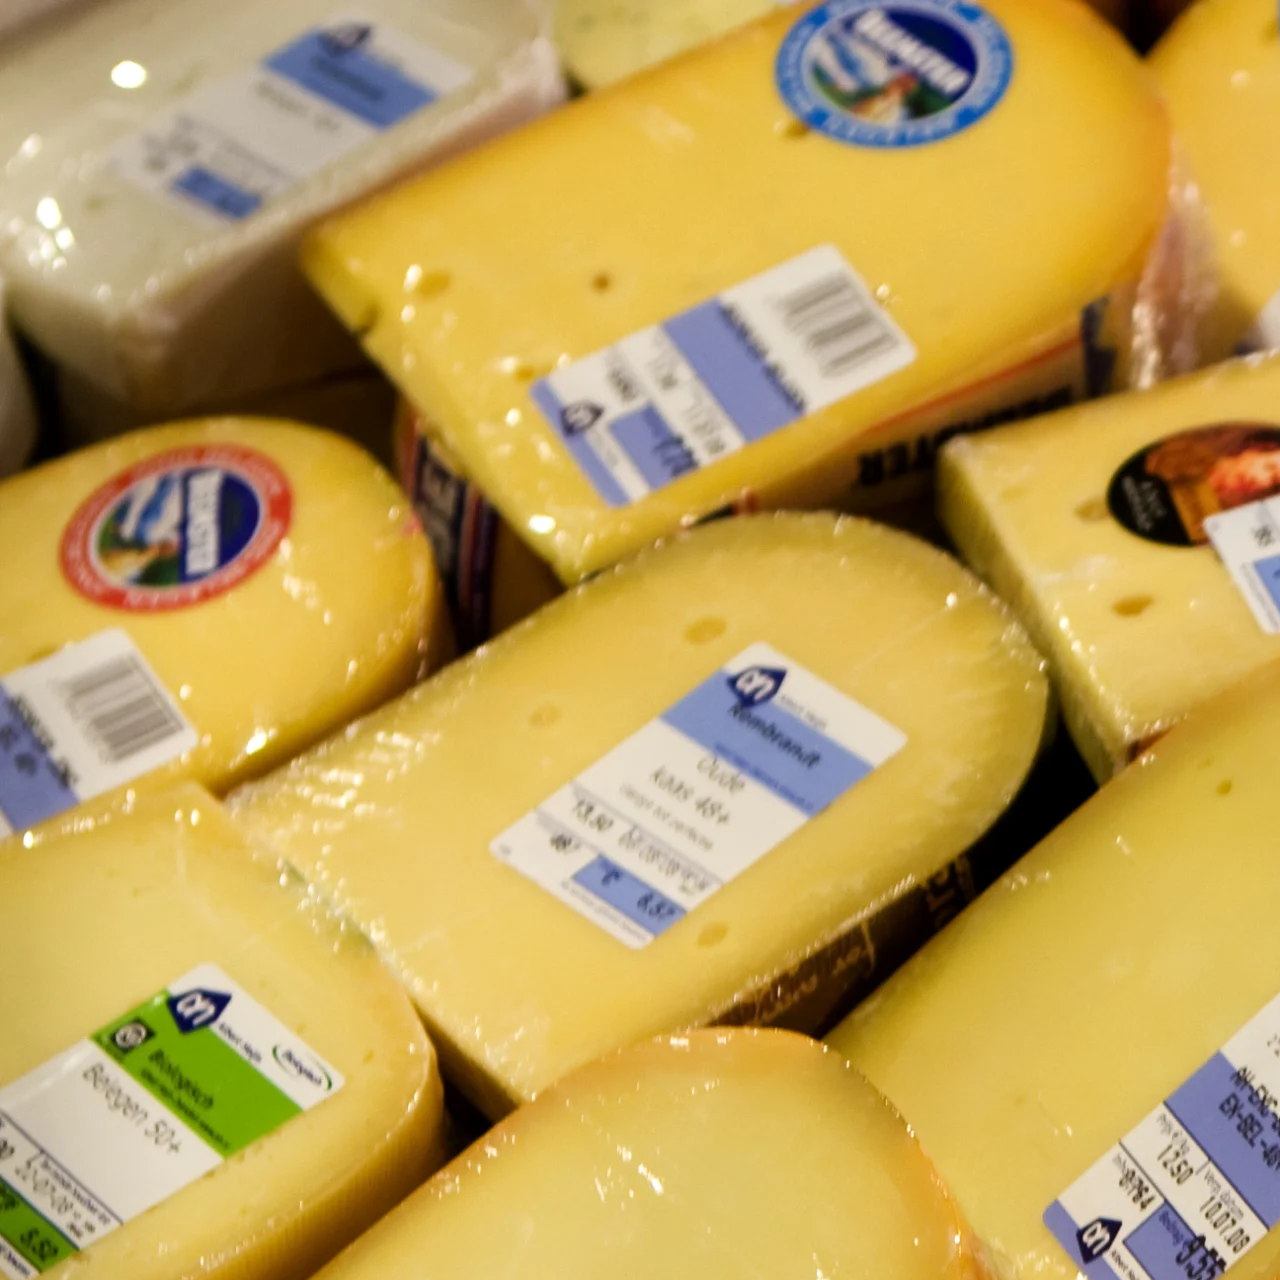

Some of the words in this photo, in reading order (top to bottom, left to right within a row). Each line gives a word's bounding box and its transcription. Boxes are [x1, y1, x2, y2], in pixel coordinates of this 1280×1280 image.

[693, 755, 748, 794] Oude
[77, 1062, 153, 1126] Belegen
[142, 1118, 185, 1155] 50+
[146, 1048, 217, 1109] Biologisch
[1198, 1194, 1251, 1254] 10.07.08
